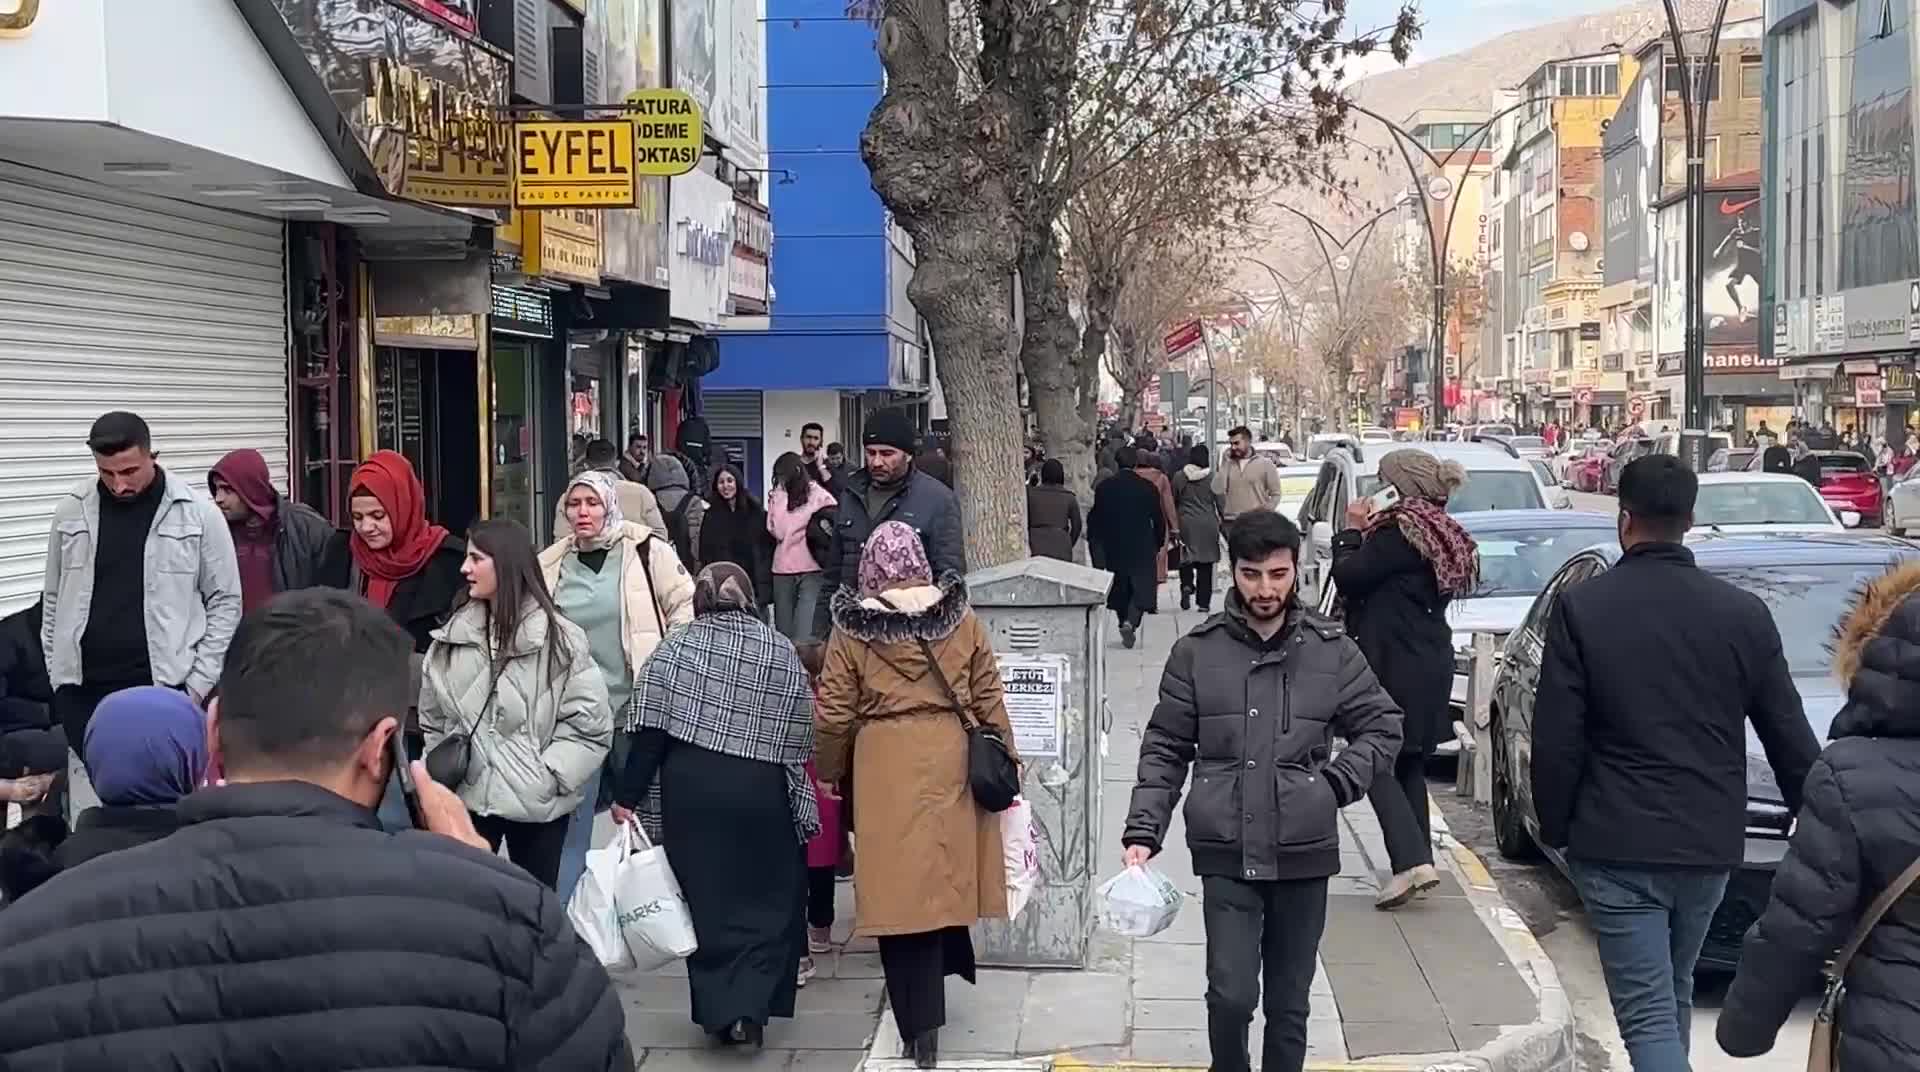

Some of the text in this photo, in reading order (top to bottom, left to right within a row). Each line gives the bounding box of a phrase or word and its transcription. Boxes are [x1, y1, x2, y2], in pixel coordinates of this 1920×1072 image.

[626, 98, 692, 116] FATURA
[519, 129, 628, 176] EYFEL
[520, 190, 630, 200] EAU DE PARFUM
[1478, 214, 1488, 254] OTEL
